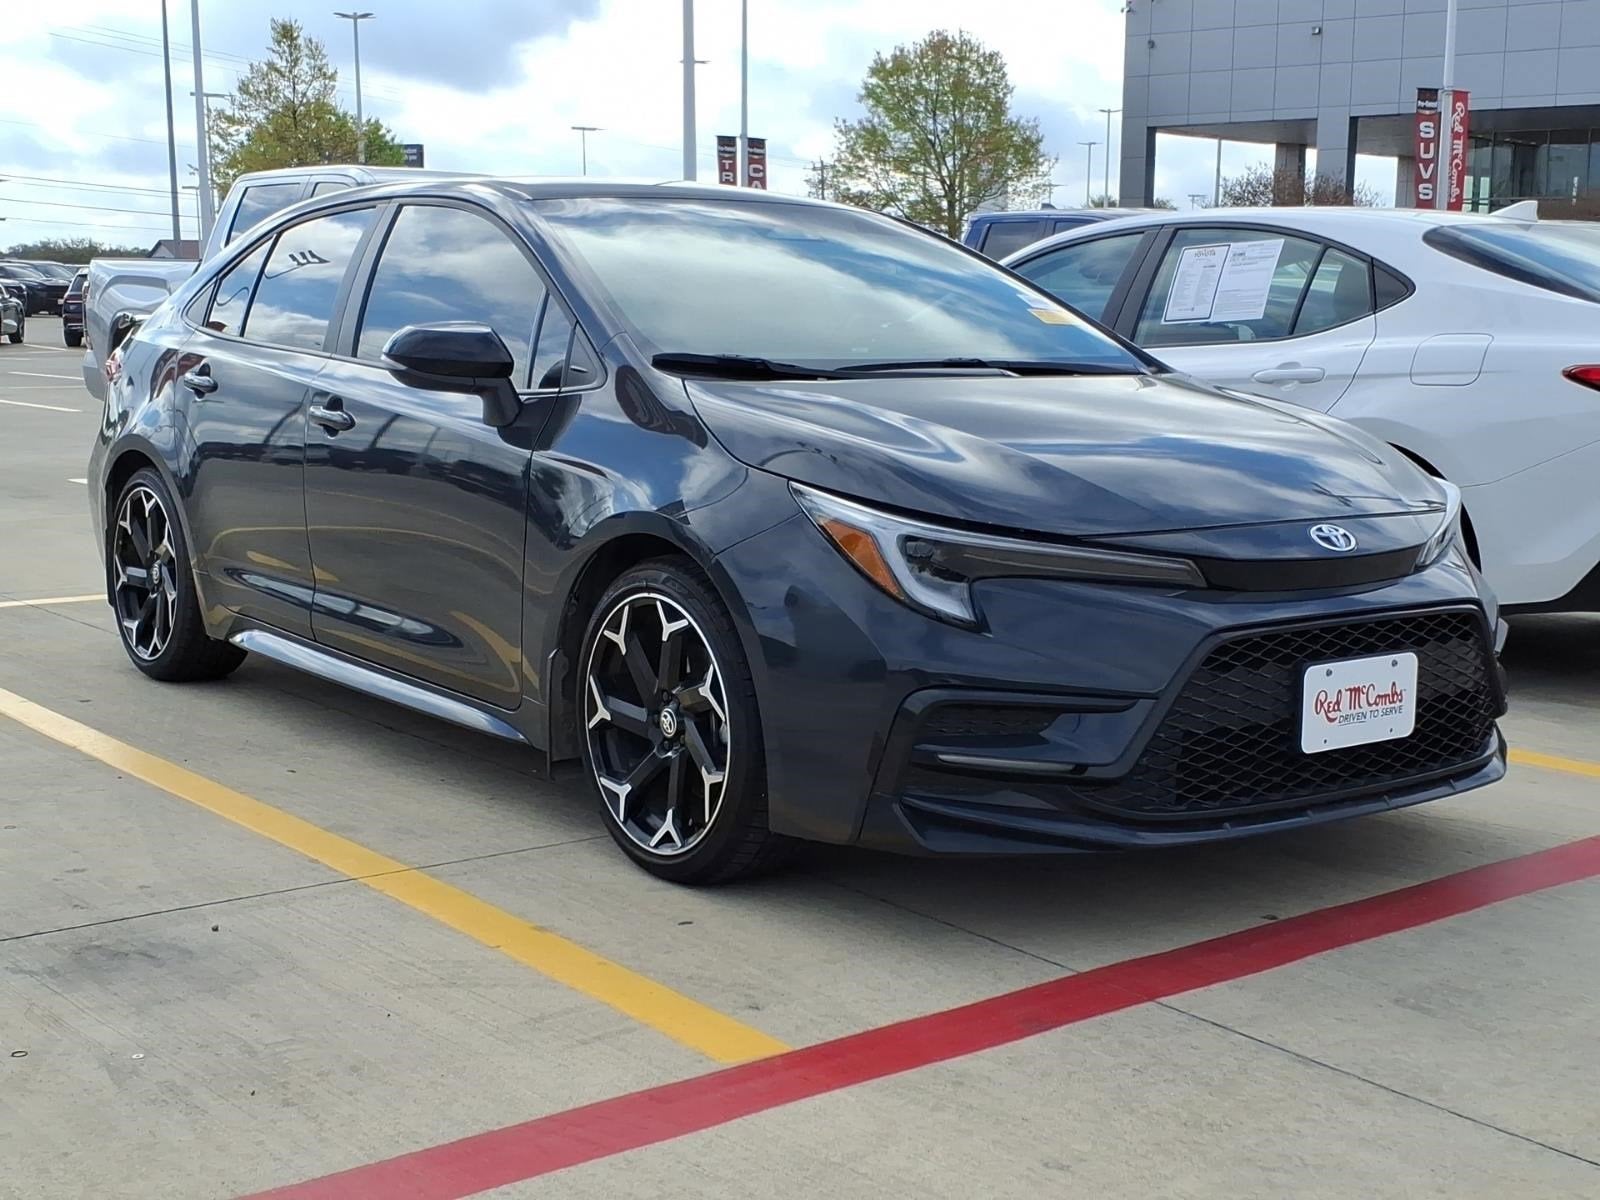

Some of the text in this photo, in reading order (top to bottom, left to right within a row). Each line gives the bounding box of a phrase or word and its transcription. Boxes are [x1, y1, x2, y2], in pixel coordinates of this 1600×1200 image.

[1418, 121, 1435, 200] SUVS
[1450, 101, 1465, 202] Red McCombs
[1315, 681, 1403, 723] Red McCombs
[1338, 705, 1404, 724] DRIVEN TO SERVE
